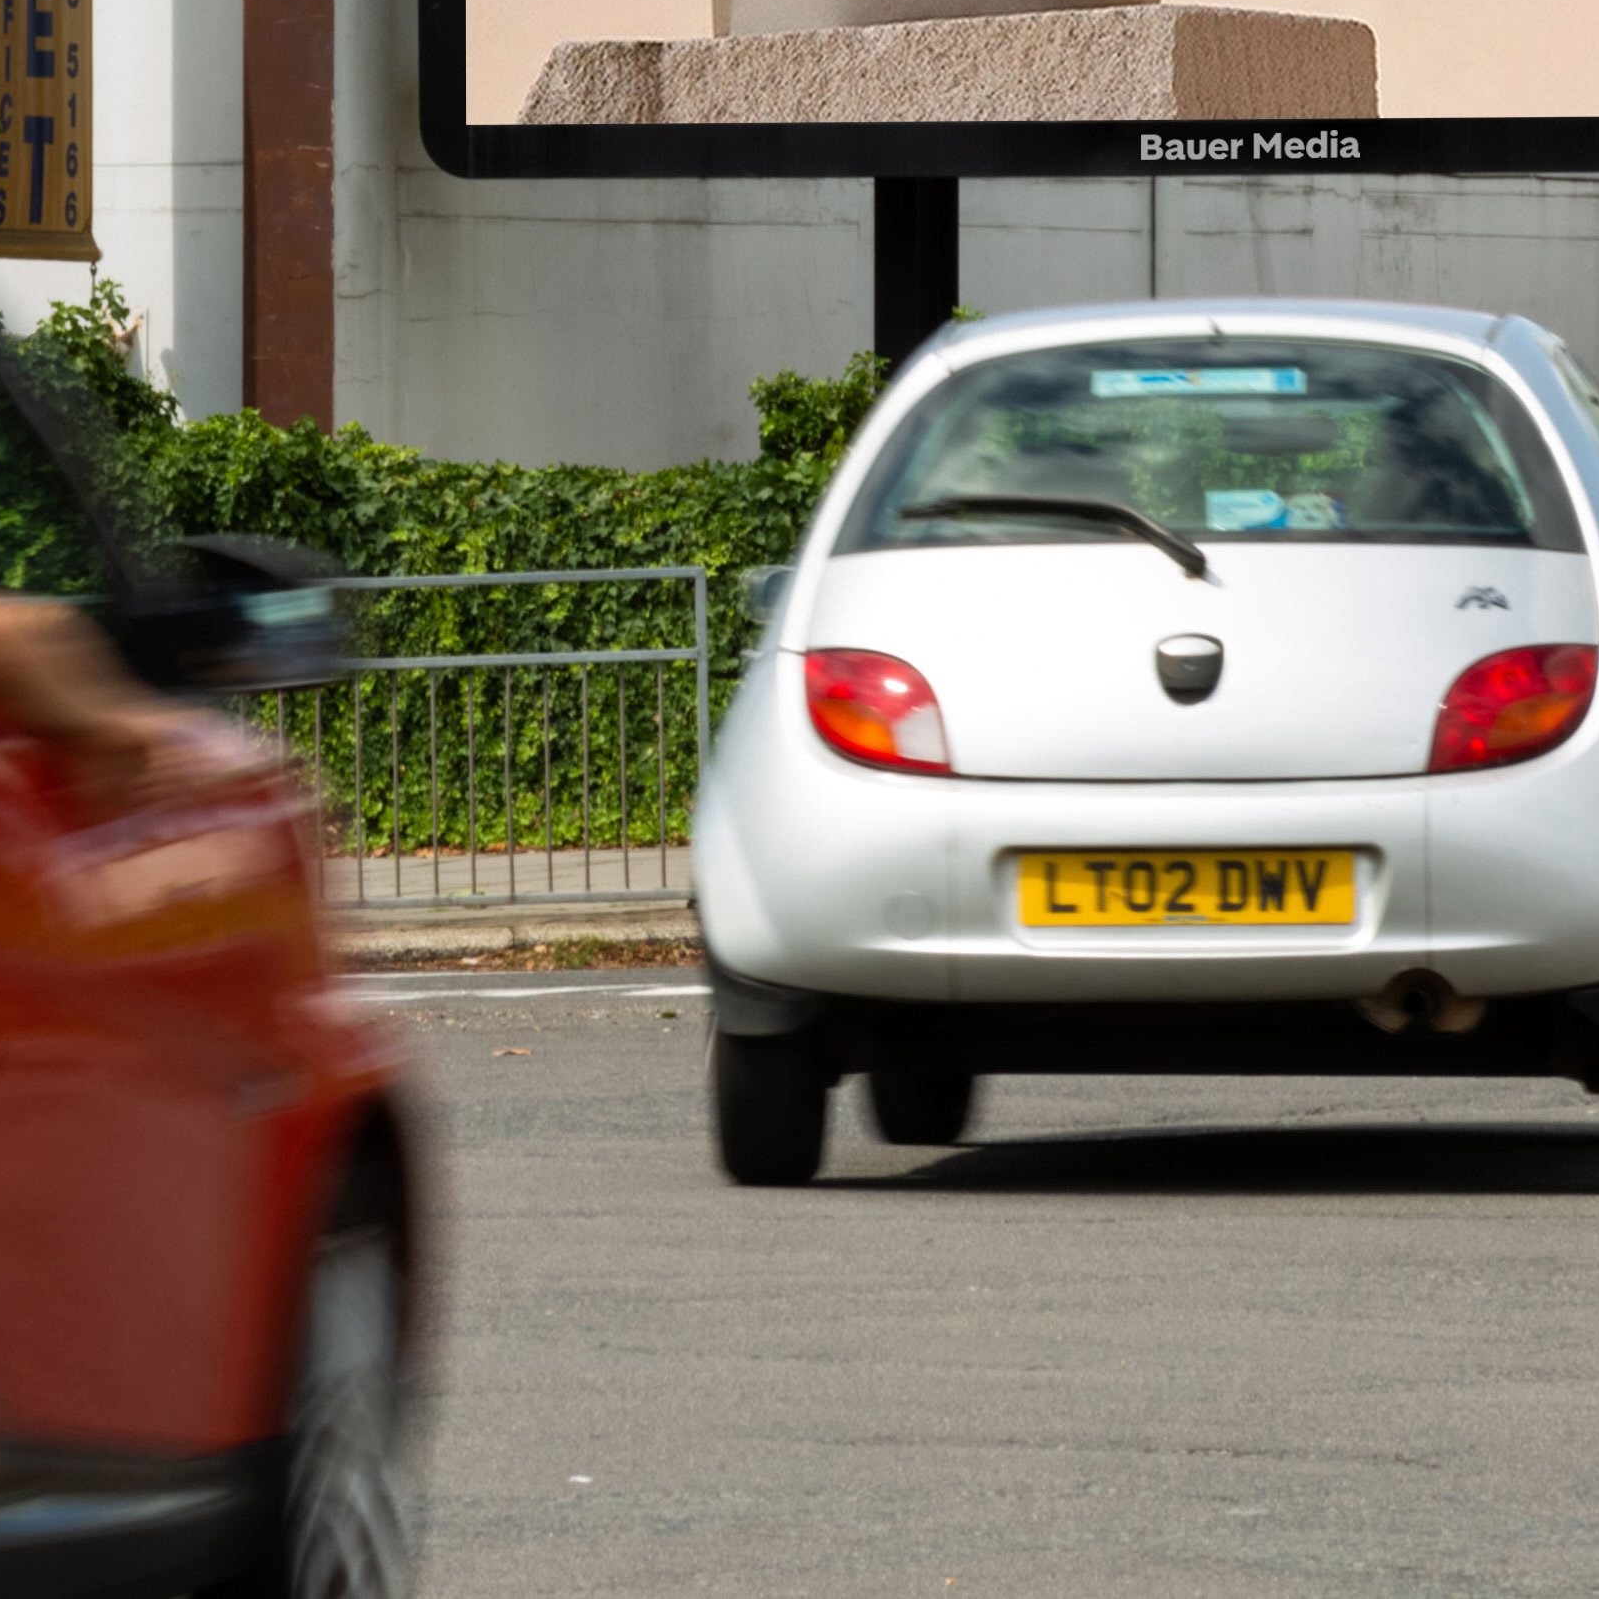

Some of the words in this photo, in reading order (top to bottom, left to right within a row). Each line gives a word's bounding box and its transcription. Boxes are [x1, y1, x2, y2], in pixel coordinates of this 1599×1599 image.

[64, 43, 79, 227] 5166
[1141, 135, 1244, 161] Bauer
[1254, 130, 1361, 160] Media
[1044, 860, 1198, 914] LT02
[1215, 859, 1329, 913] DWV
